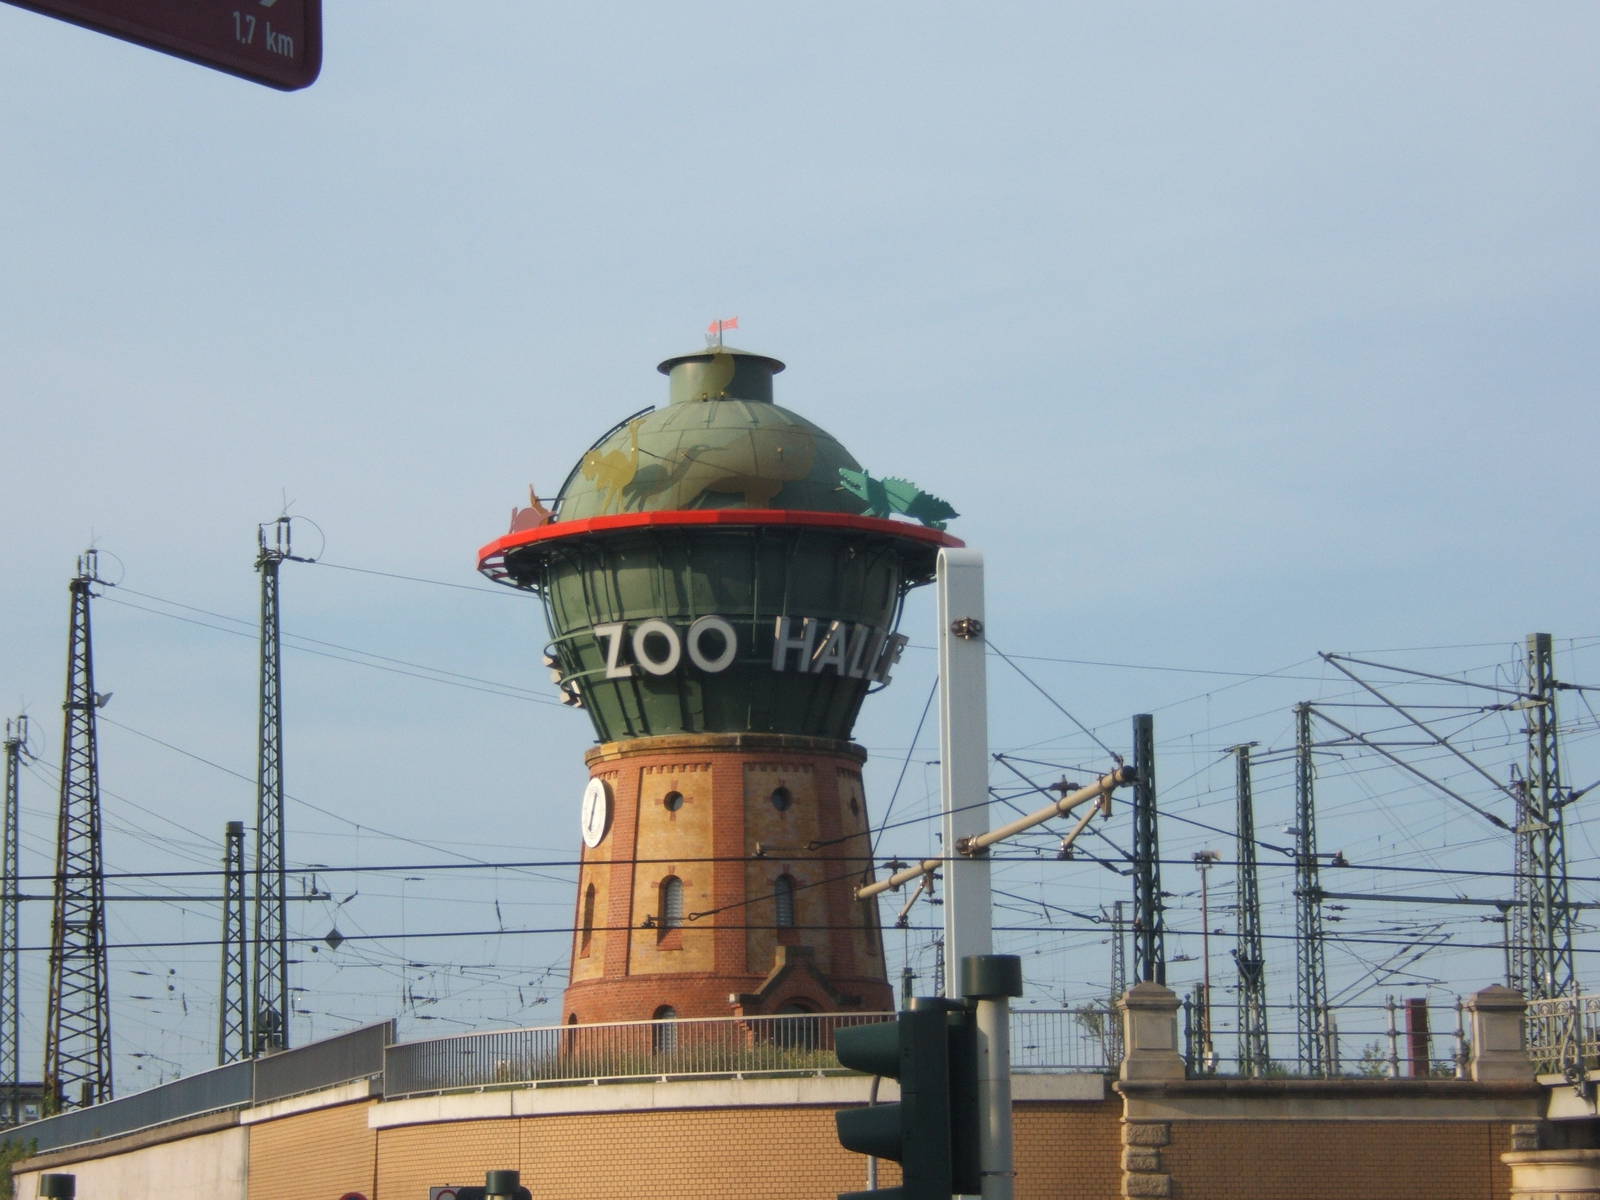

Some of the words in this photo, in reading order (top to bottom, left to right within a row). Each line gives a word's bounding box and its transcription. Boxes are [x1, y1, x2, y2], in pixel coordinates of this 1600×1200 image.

[233, 11, 256, 44] 1.7
[266, 21, 294, 58] km
[594, 615, 737, 678] ZOO
[772, 615, 909, 685] HALLE
